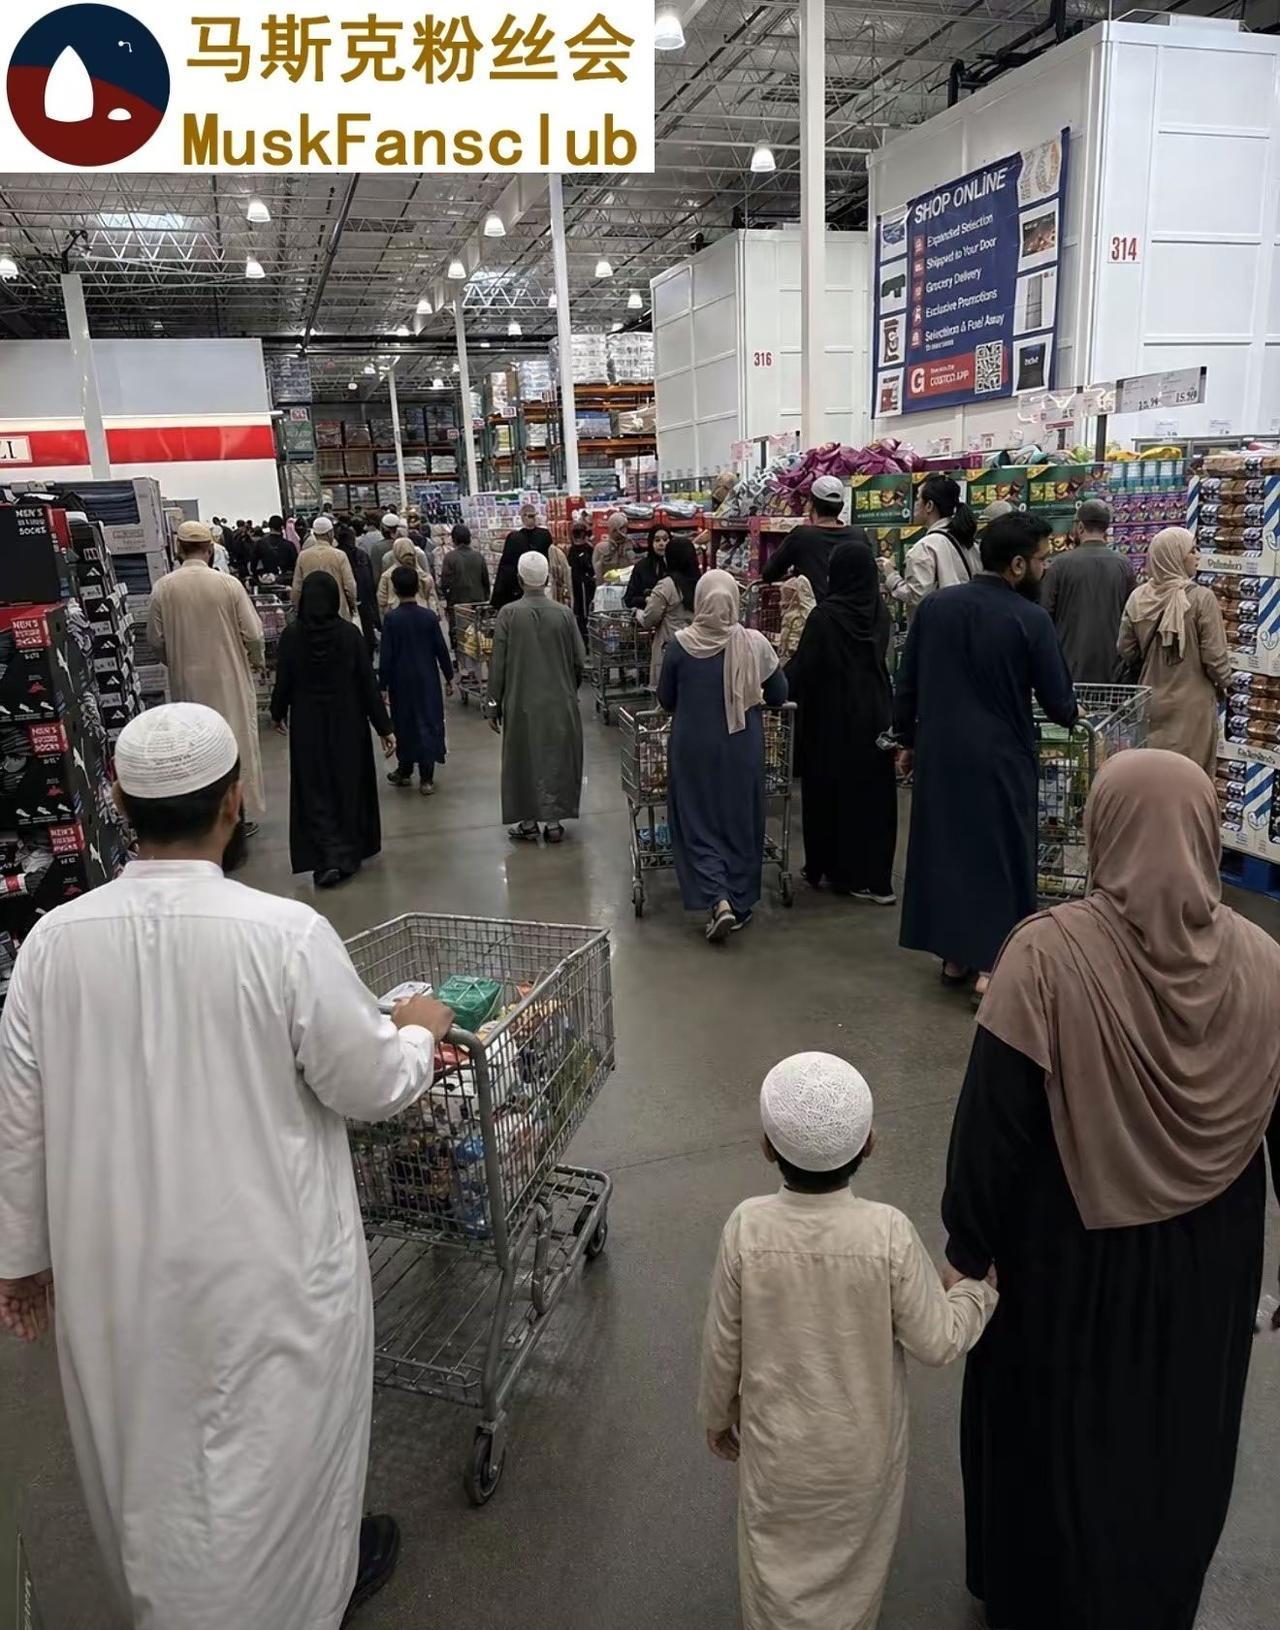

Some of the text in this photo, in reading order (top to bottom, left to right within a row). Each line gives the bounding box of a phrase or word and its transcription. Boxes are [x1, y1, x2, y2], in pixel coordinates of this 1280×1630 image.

[914, 167, 1009, 224] SHOP ONLINE
[1111, 236, 1137, 261] 314
[754, 352, 772, 367] 316
